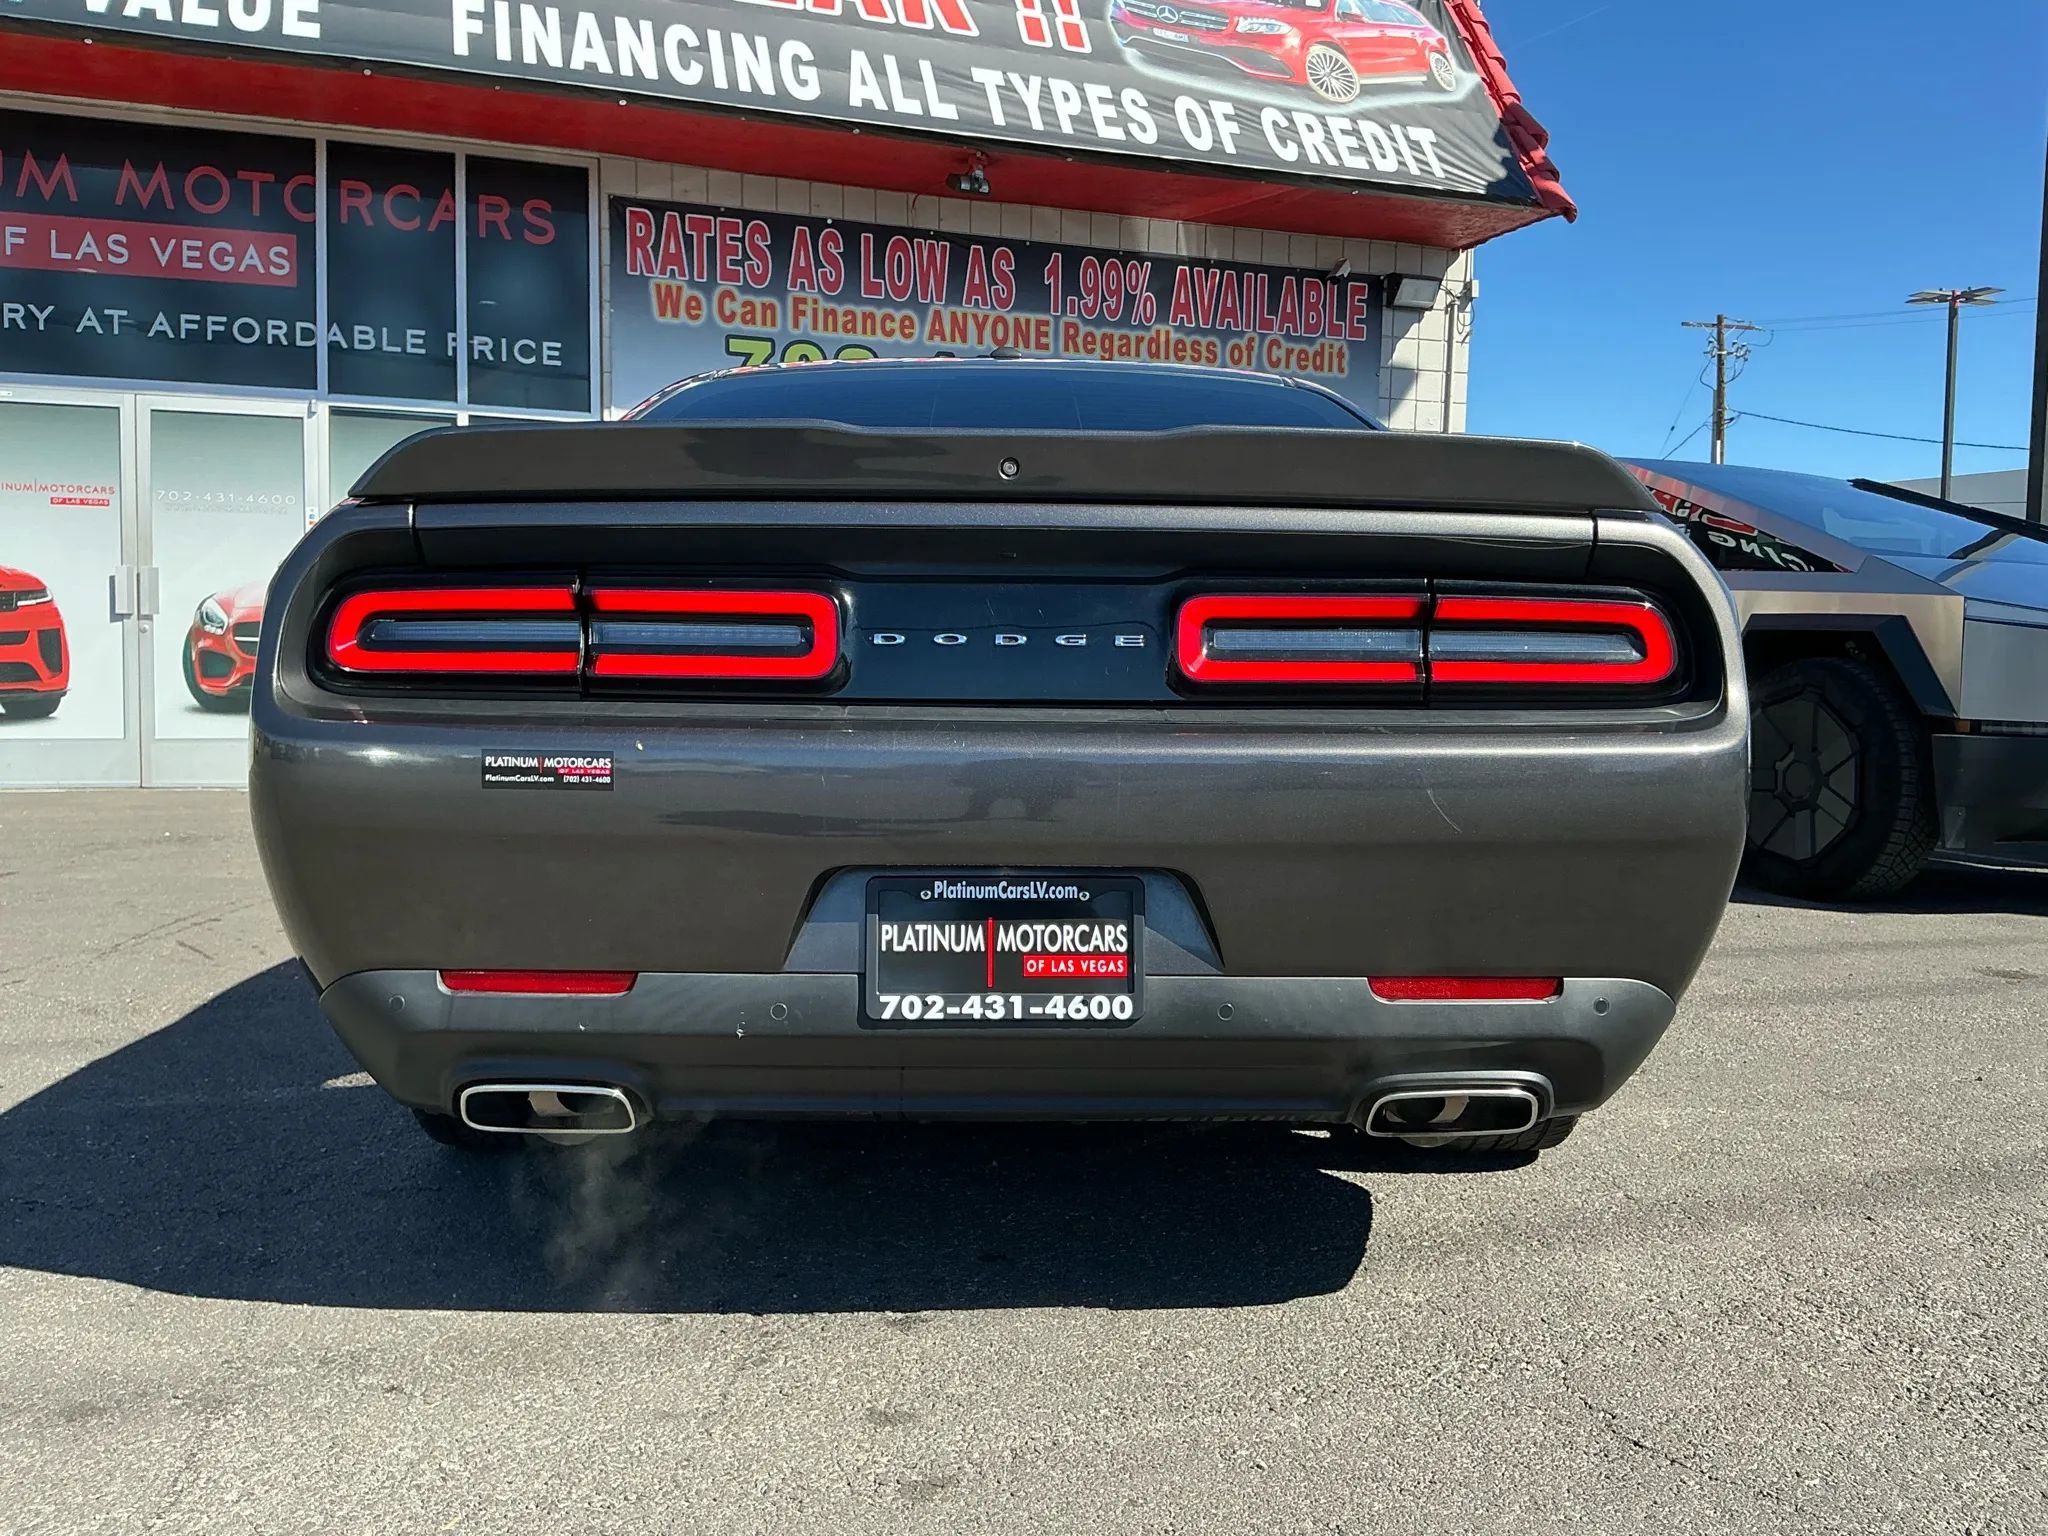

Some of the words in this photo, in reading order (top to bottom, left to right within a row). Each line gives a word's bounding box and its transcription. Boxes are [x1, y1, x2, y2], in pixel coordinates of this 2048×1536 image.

[83, 0, 321, 39] LUE
[452, 0, 822, 102] FINANCING
[848, 50, 959, 120] ALL
[970, 67, 1158, 145] TYPES
[1174, 95, 1243, 155] OF
[1261, 106, 1446, 179] CREDIT
[0, 149, 78, 202] M
[115, 158, 556, 245] MOTORCARS
[50, 229, 129, 264] LAS
[149, 237, 290, 276] VEGAS
[625, 207, 772, 289] RATES
[787, 226, 844, 295] AS
[860, 233, 950, 305] LOW
[962, 245, 1016, 311] AS
[1043, 252, 1157, 327] 1.99%
[1169, 265, 1368, 341] AVAILABLE
[3, 302, 55, 331] RY
[75, 307, 128, 335] AT
[147, 311, 427, 355] AFFORDABLE
[447, 332, 562, 367] PRICE
[655, 283, 702, 321] We
[717, 289, 777, 328] Can
[792, 297, 915, 339] Finance
[927, 309, 1050, 350] ANYONE
[1062, 313, 1219, 367] Regardless
[1228, 338, 1256, 368] of
[1266, 339, 1348, 375] Credit
[39, 484, 115, 495] MOTORCARS
[873, 633, 1145, 647] DODGE
[485, 756, 538, 767] PLATINUM
[544, 757, 612, 768] MOTORCARS
[485, 774, 554, 782] PlatinumCarsLV.com
[563, 775, 580, 783] (702)
[581, 775, 611, 783] 431-4600
[934, 880, 1078, 900] PlatinumCarsLV.com
[881, 924, 985, 952] PLATINUM
[997, 924, 1128, 953] MOTORCARS
[1026, 960, 1045, 973] OF
[1051, 960, 1075, 973] LAS
[1080, 960, 1124, 973] VEGAS
[879, 995, 1134, 1020] 702-431-4600
